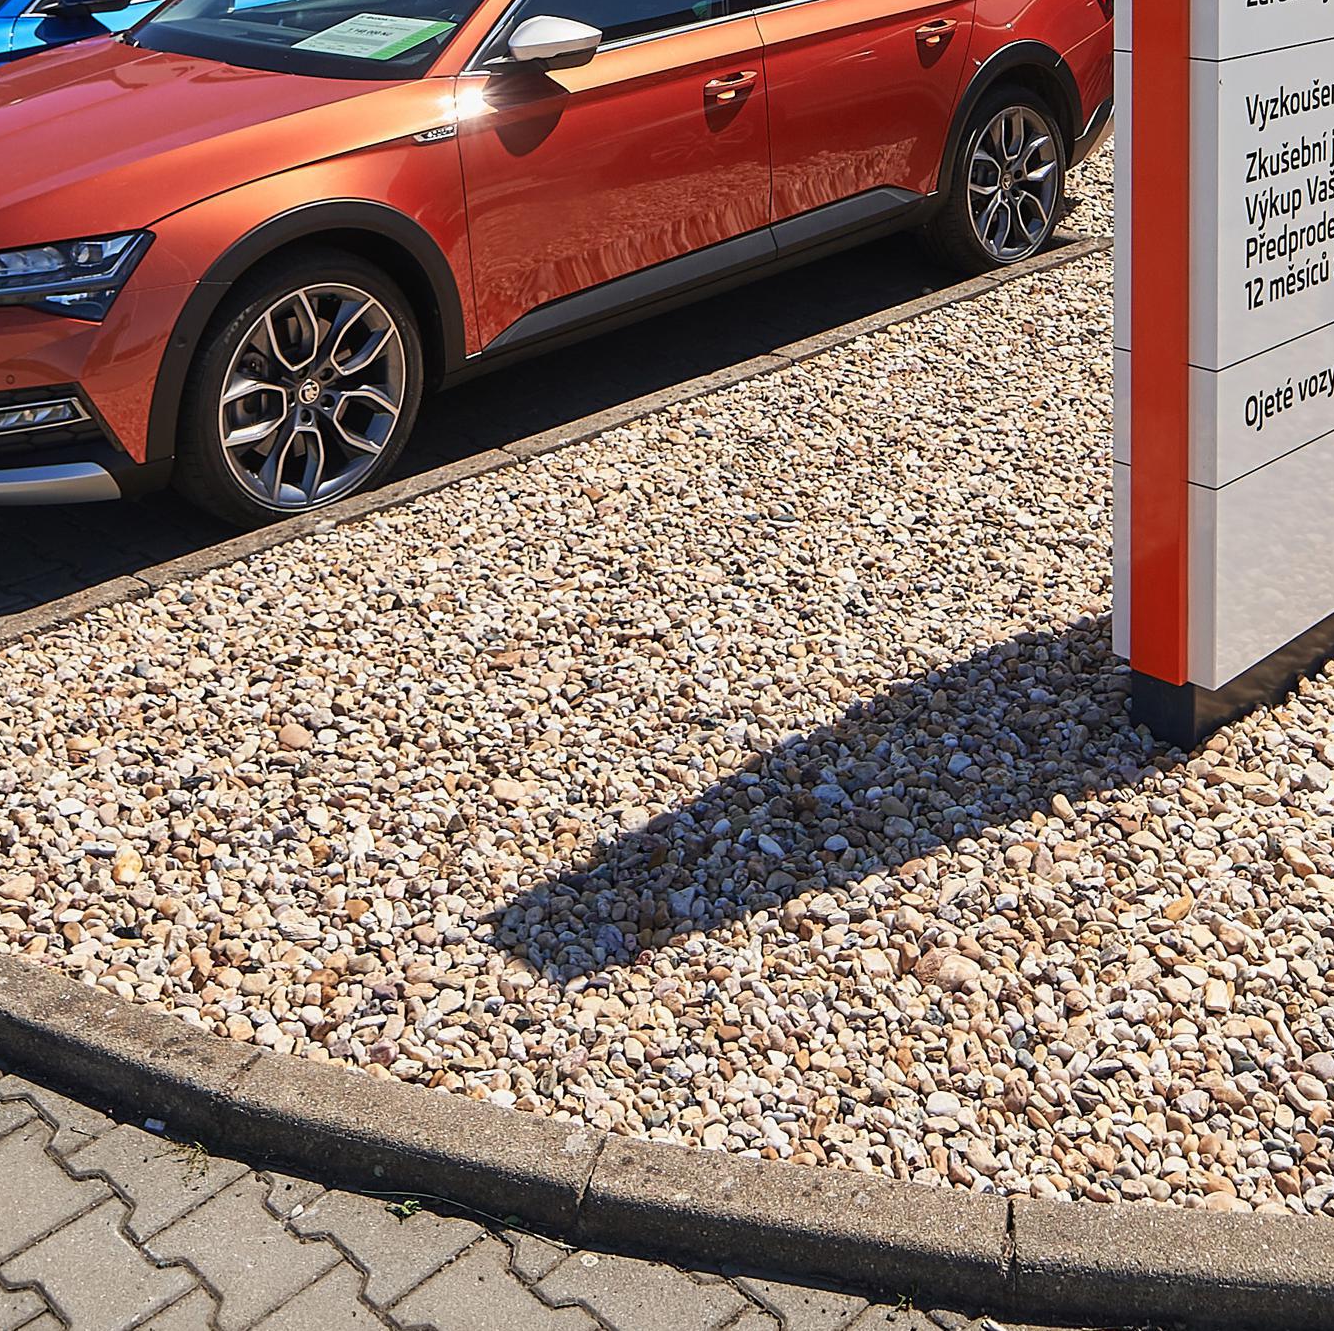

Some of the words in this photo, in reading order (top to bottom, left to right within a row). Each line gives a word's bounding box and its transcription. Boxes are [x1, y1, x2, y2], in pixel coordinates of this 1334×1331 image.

[1245, 131, 1328, 184] Zkušební
[1245, 186, 1302, 232] Výkup
[1244, 277, 1264, 311] 12
[1269, 251, 1329, 303] měsíců
[1245, 377, 1294, 432] Ojeté
